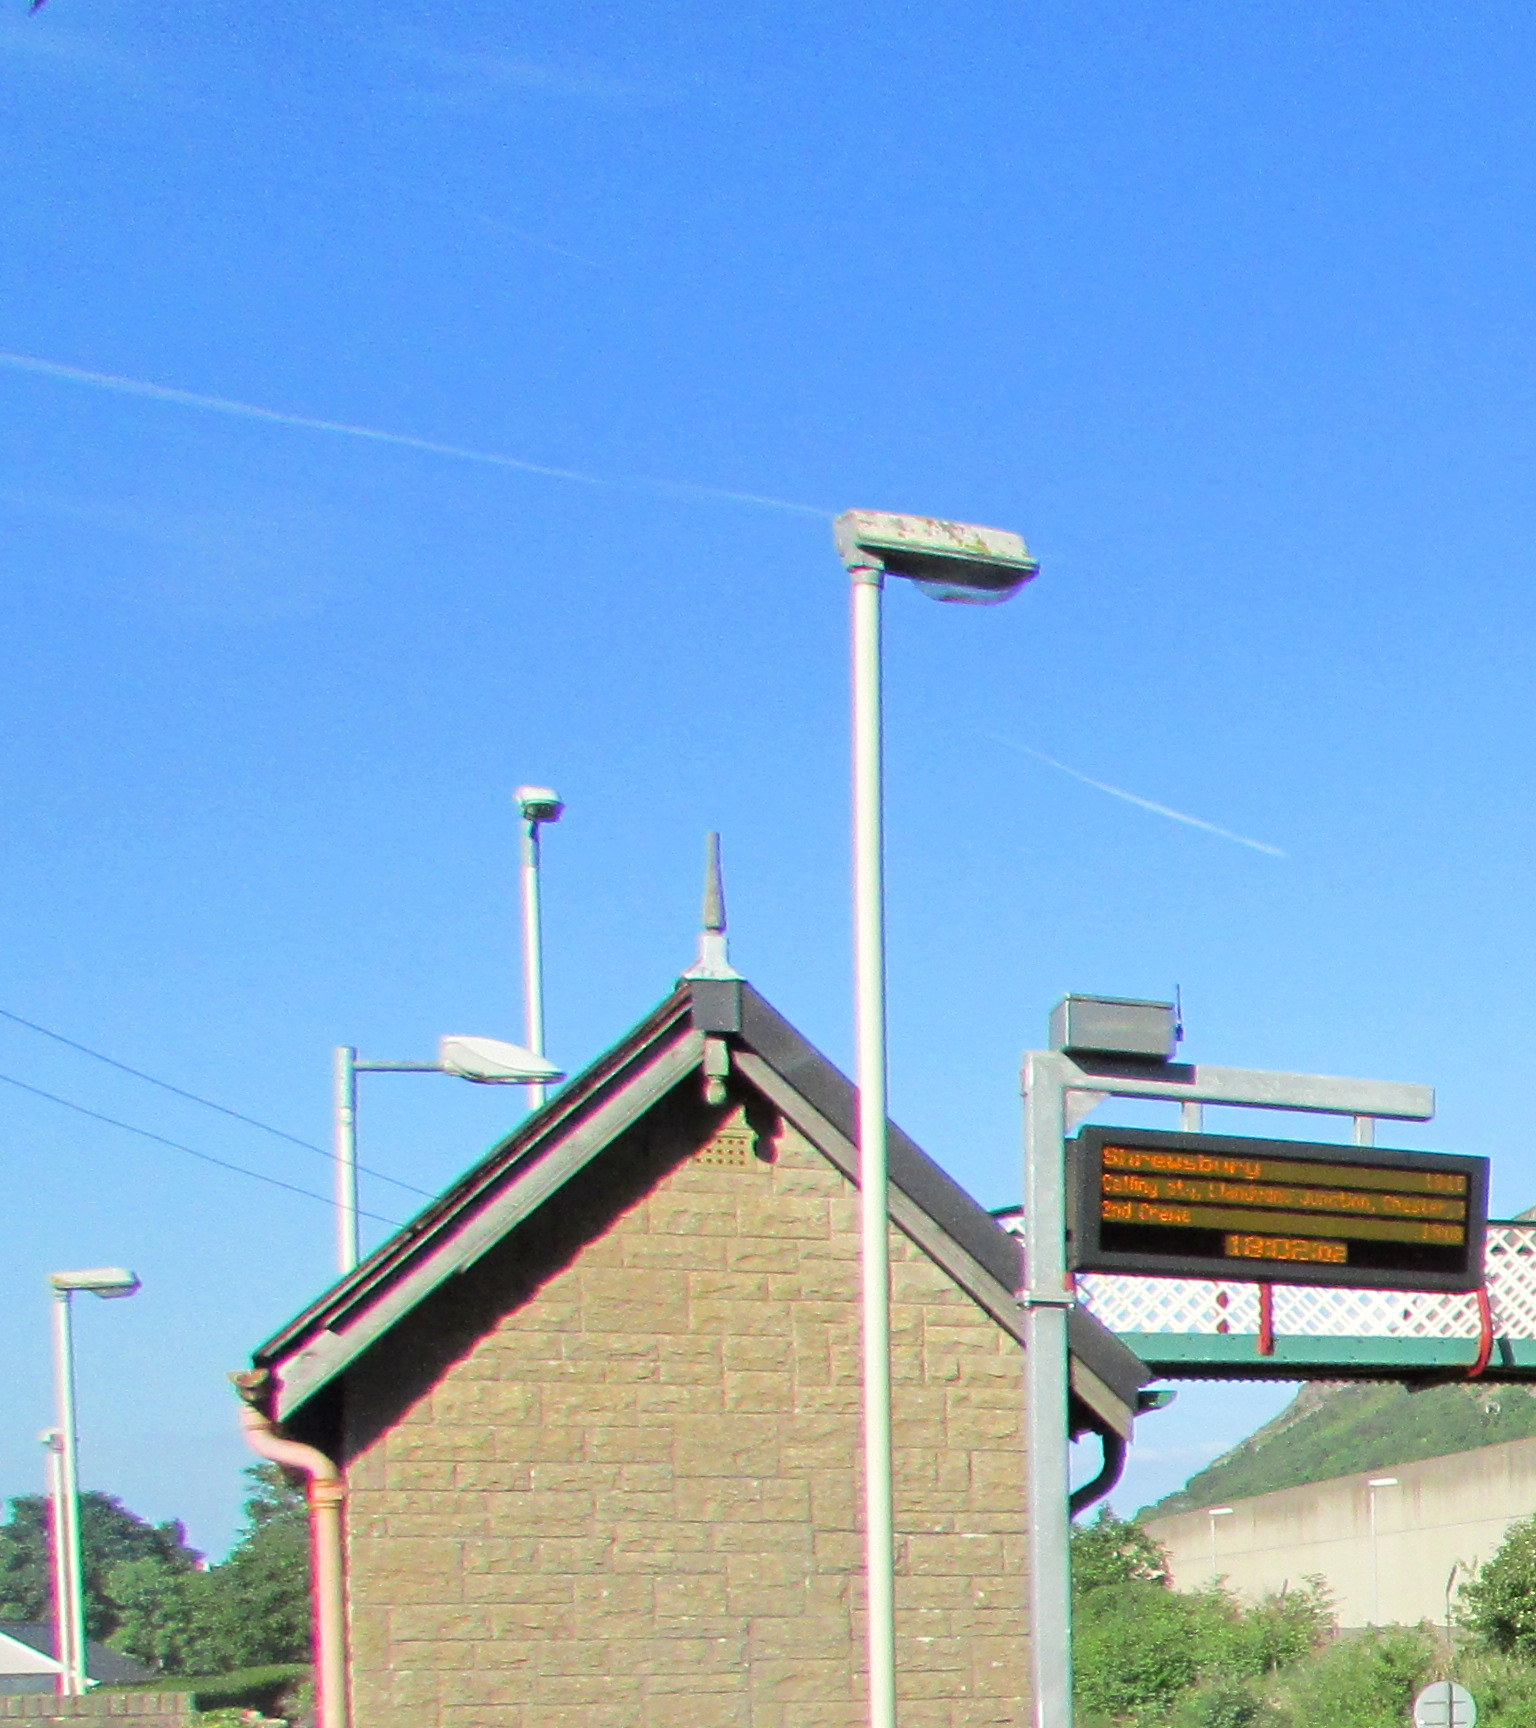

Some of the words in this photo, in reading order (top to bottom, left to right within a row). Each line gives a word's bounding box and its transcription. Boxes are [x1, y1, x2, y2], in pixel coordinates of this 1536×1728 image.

[1103, 1146, 1261, 1179] Shrewsbury
[1102, 1174, 1159, 1198] Calling
[1102, 1200, 1132, 1219] 2nd
